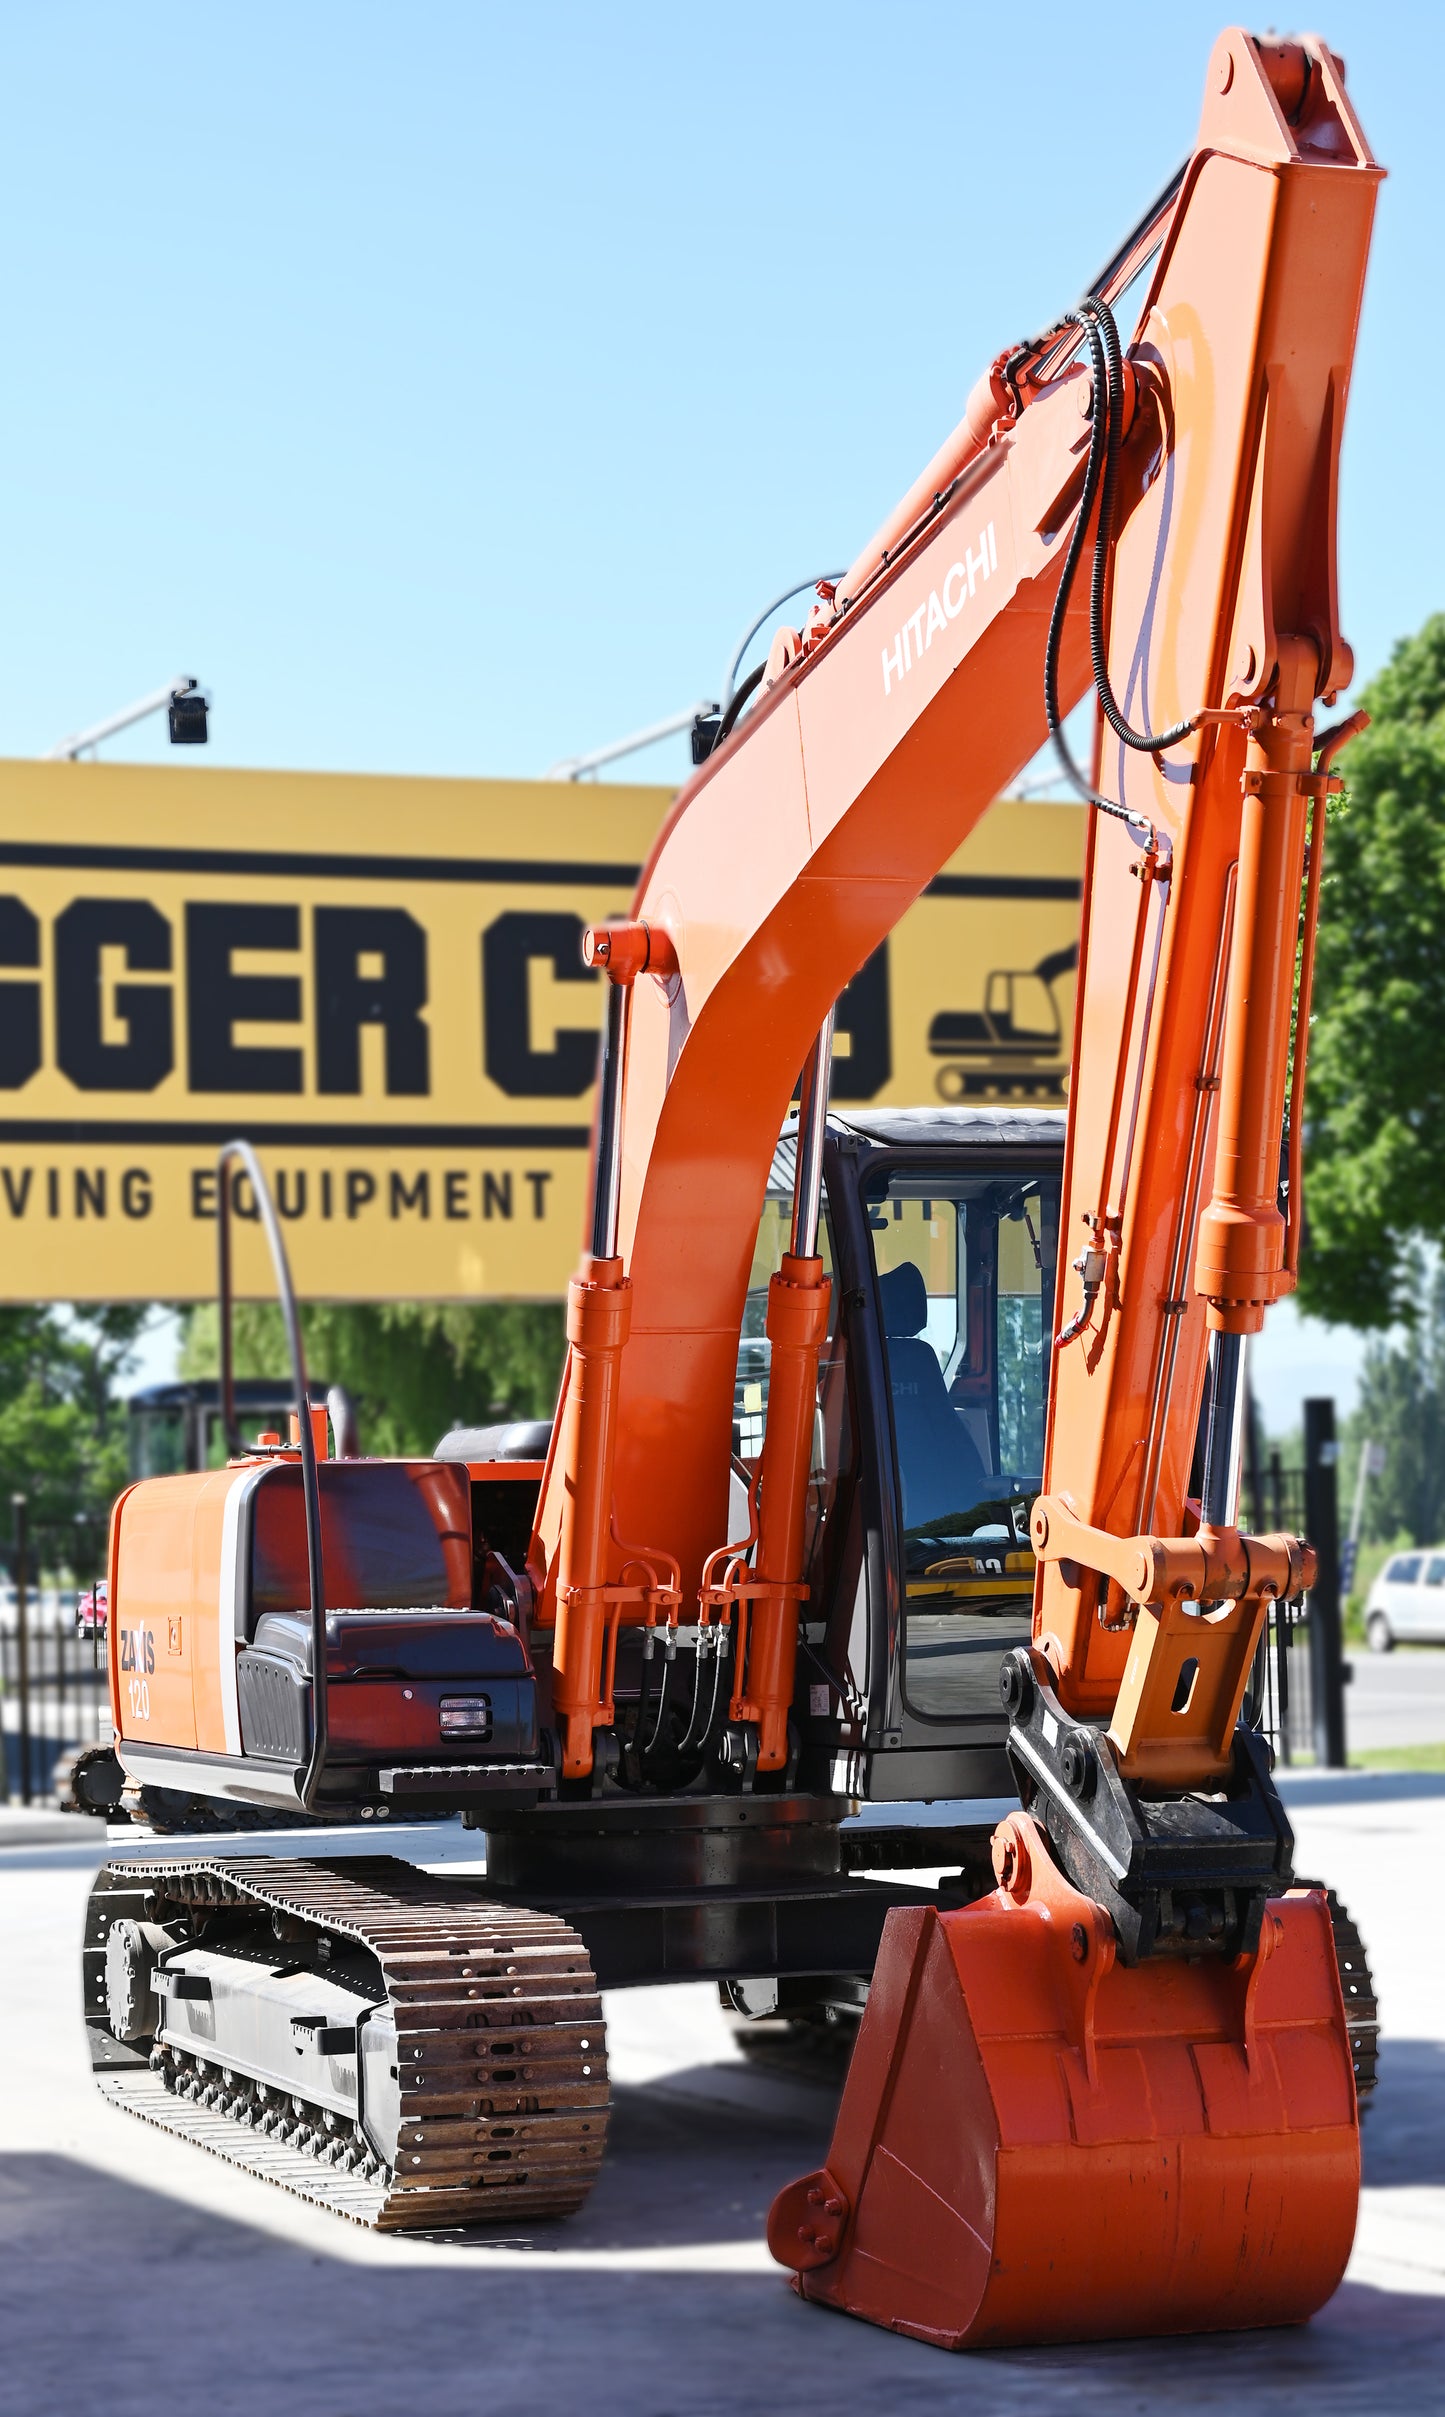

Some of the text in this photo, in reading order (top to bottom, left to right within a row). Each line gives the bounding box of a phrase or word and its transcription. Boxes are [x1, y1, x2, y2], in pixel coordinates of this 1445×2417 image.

[880, 520, 998, 696] HITACHI
[190, 1168, 554, 1225] EQUIPMENT
[120, 1620, 155, 1675] ZAXIS
[128, 1678, 150, 1721] 120
